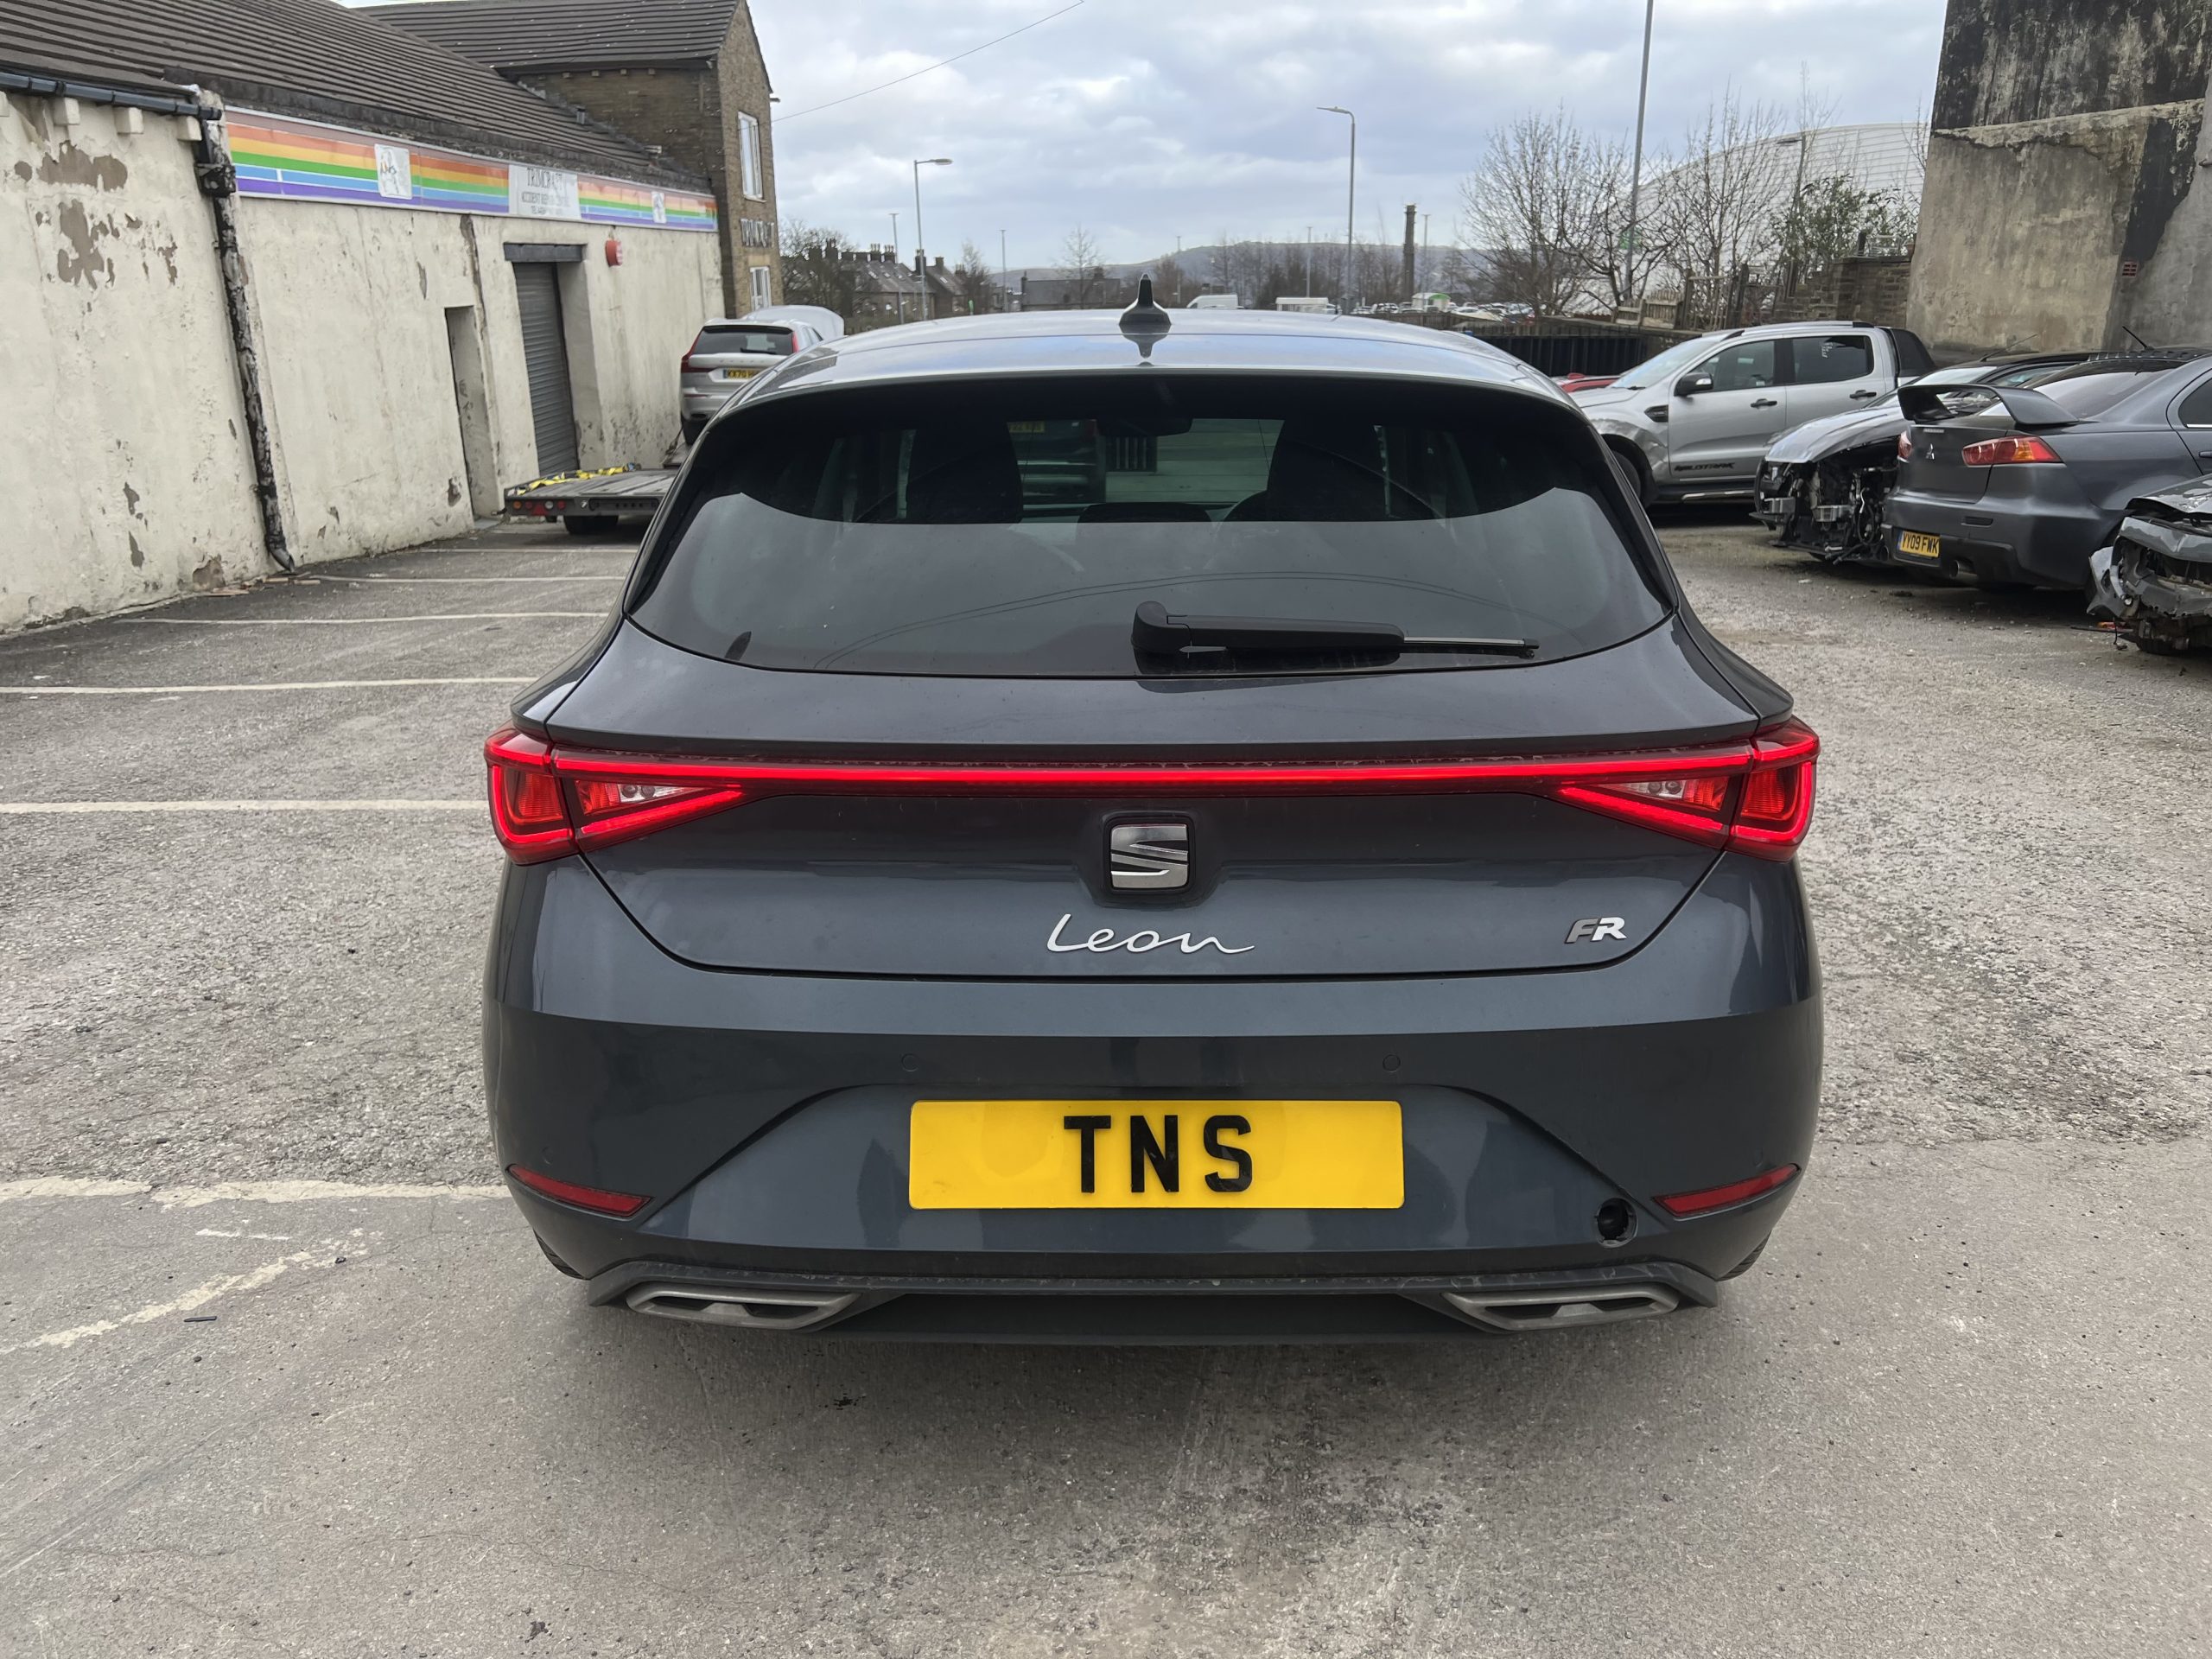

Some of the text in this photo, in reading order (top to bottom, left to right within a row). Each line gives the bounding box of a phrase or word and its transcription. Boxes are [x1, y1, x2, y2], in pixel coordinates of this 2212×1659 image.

[1902, 532, 1940, 554] YY09 FWK
[1047, 913, 1255, 955] Leon
[1565, 917, 1627, 944] FR
[1064, 1115, 1254, 1193] TNS
